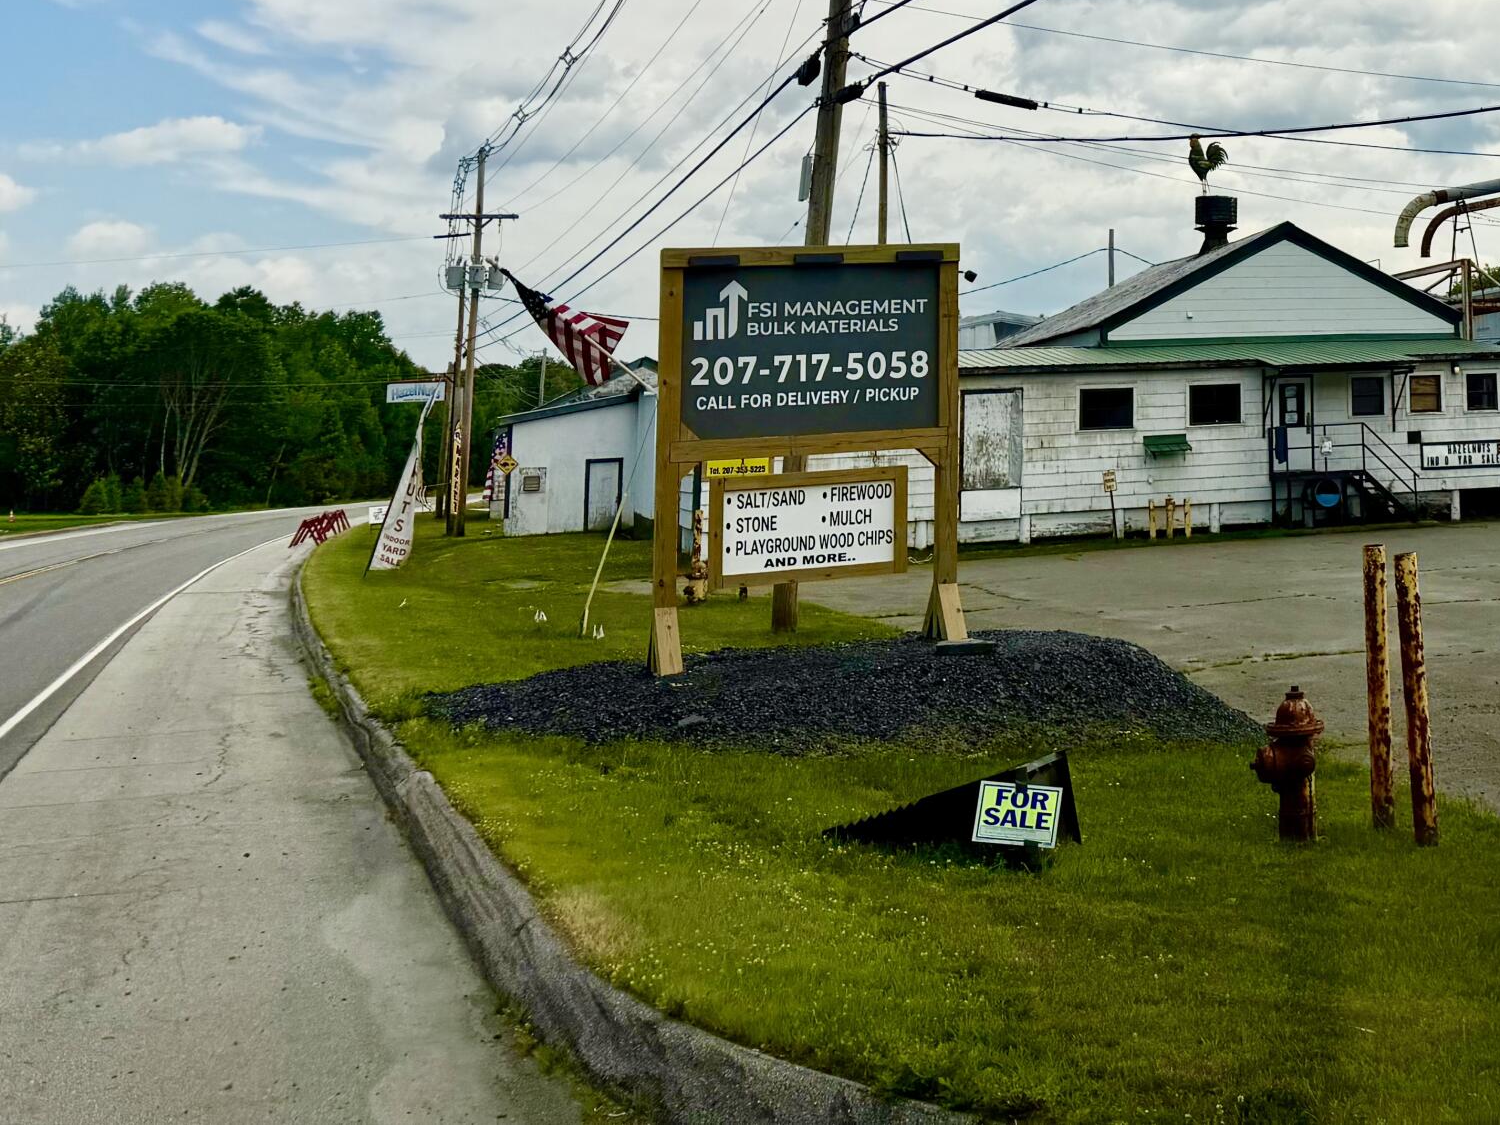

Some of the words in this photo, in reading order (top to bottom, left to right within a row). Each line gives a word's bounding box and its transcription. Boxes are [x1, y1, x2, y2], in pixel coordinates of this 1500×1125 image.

[748, 302, 777, 318] FSI
[784, 299, 928, 317] MANAGEMENT
[747, 321, 796, 336] BULK
[801, 318, 899, 335] MATERIALS
[690, 350, 929, 386] 207-717-5058
[696, 395, 736, 410] CALL
[741, 393, 771, 409] FOR
[777, 389, 849, 406] DELIVERY
[865, 387, 919, 402] PICKUP
[1447, 443, 1491, 454] HAZELNUTS
[1481, 454, 1500, 464] SALE
[736, 489, 806, 509] SALT/SAND
[830, 483, 892, 502] FIREWOOD
[736, 515, 778, 533] STONE
[829, 509, 872, 526] MULCH
[383, 533, 411, 546] INDOOR
[735, 535, 816, 556] PLAYGROUND
[819, 532, 854, 550] WOOD
[857, 529, 893, 546] CHIPS
[382, 543, 407, 556] YARD
[379, 554, 402, 567] SALE
[764, 556, 797, 568] AND
[995, 788, 1050, 811] FOR
[983, 807, 1052, 830] SALE
